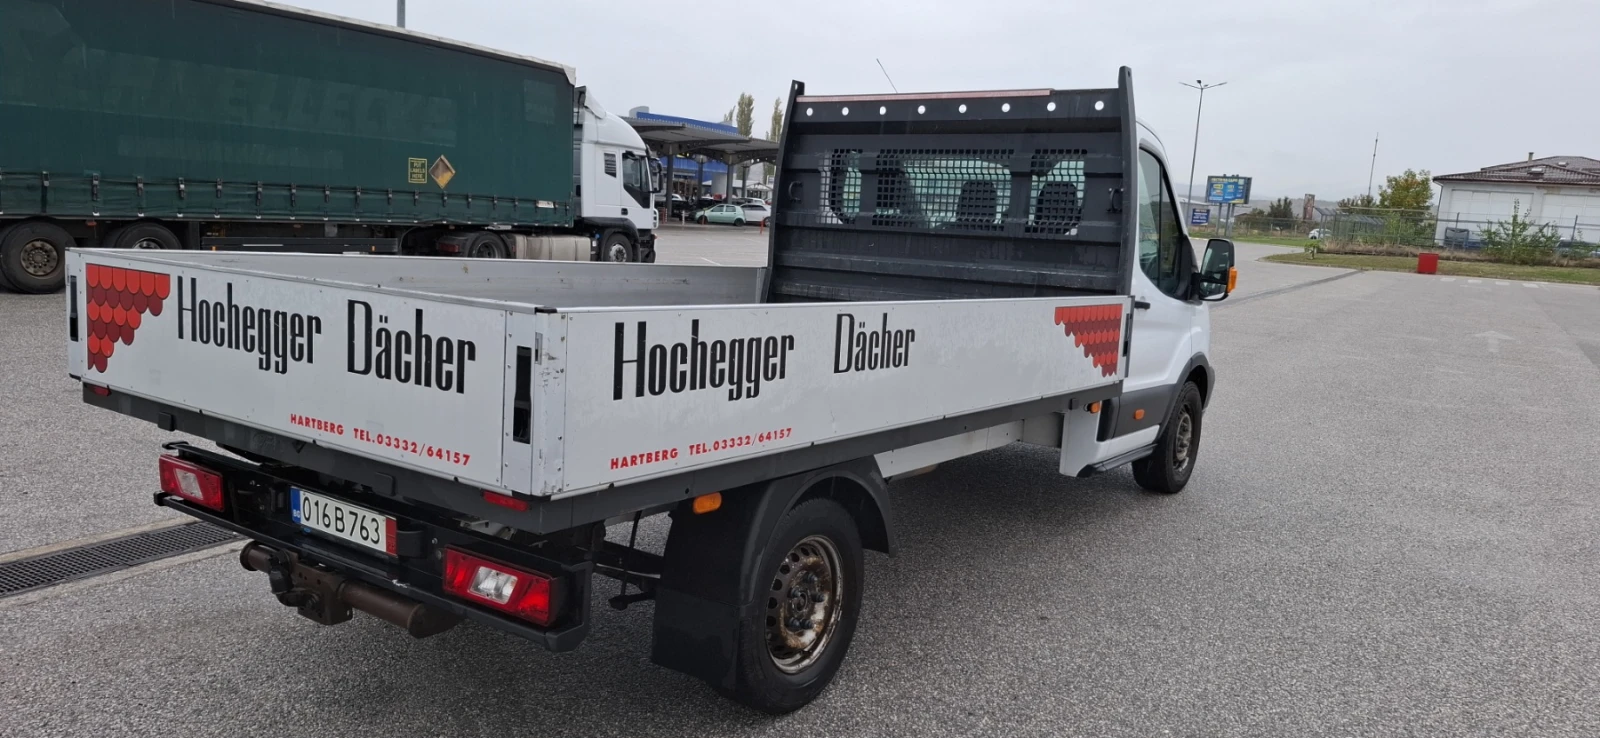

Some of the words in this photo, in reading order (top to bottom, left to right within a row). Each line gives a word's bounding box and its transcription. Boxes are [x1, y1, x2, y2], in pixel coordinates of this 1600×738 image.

[177, 275, 322, 375] Hochegger
[347, 299, 476, 395] Dächer
[612, 318, 795, 402] Hochegger
[833, 312, 916, 374] Dächer
[290, 413, 344, 436] HARTBERG
[353, 428, 471, 466] TEL.03332/64157
[609, 447, 680, 471] HARTBERG
[688, 427, 792, 456] TEL.03332/64157
[292, 509, 301, 519] BG
[302, 496, 381, 545] 016B763
